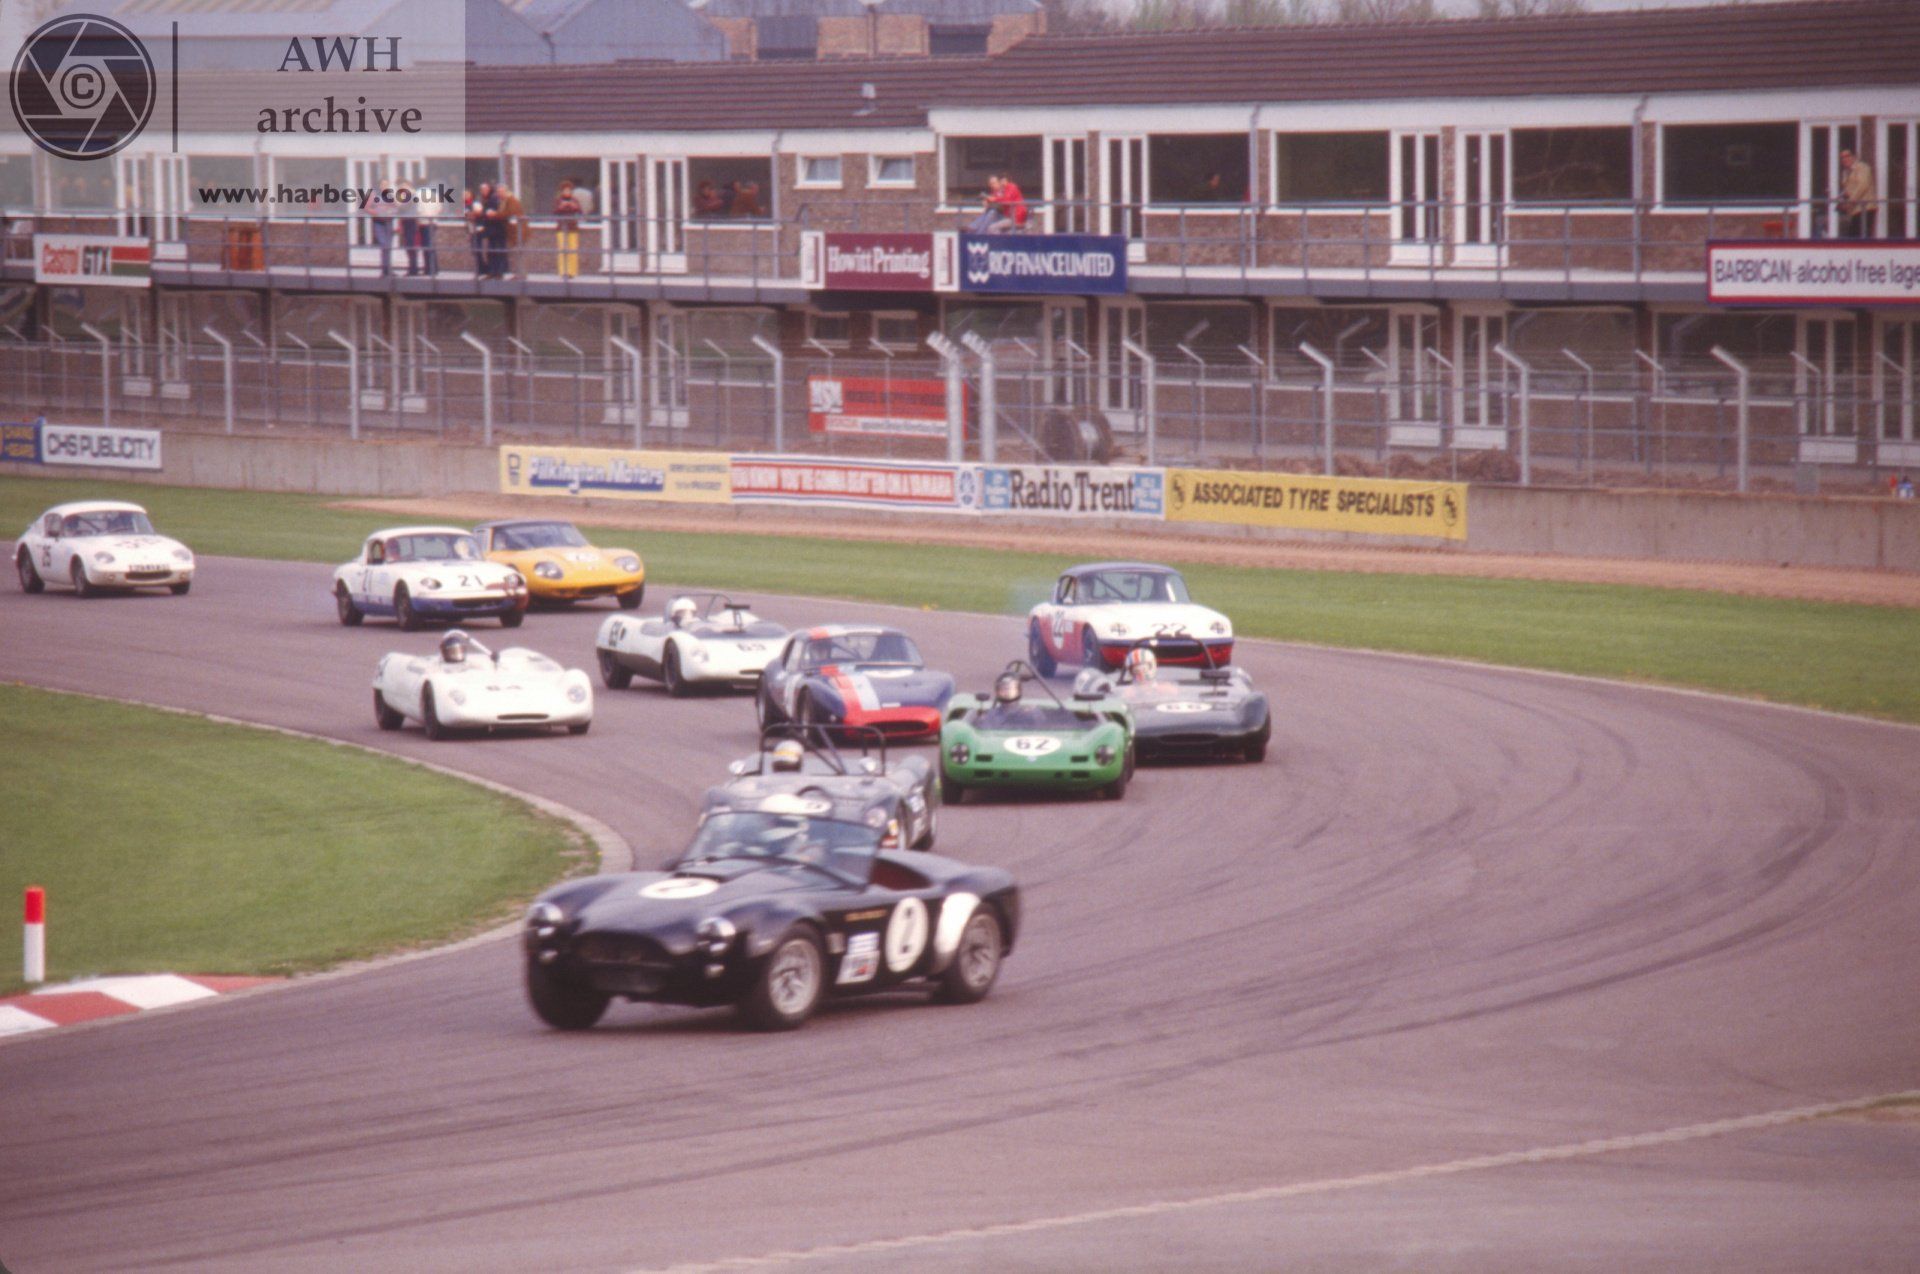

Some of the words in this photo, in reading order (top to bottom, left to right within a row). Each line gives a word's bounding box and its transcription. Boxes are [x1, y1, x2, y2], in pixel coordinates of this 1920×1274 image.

[83, 245, 111, 275] GTX
[828, 246, 871, 273] Howitt
[873, 246, 930, 279] Printing
[1015, 252, 1064, 276] FINANCE
[1065, 253, 1115, 278] LIMITED
[1856, 259, 1886, 284] free
[80, 435, 156, 461] PUBLICITY
[529, 455, 606, 494] Pilkington
[608, 457, 665, 488] Motors
[1010, 468, 1072, 511] Radio
[1075, 471, 1135, 512] Trent
[1194, 483, 1283, 508] ASSOCIATED
[1289, 488, 1331, 511] TYRE
[1337, 489, 1434, 517] SPECIALISTS
[457, 574, 484, 588] 21
[1152, 622, 1193, 639] 22
[1015, 738, 1050, 751] 62
